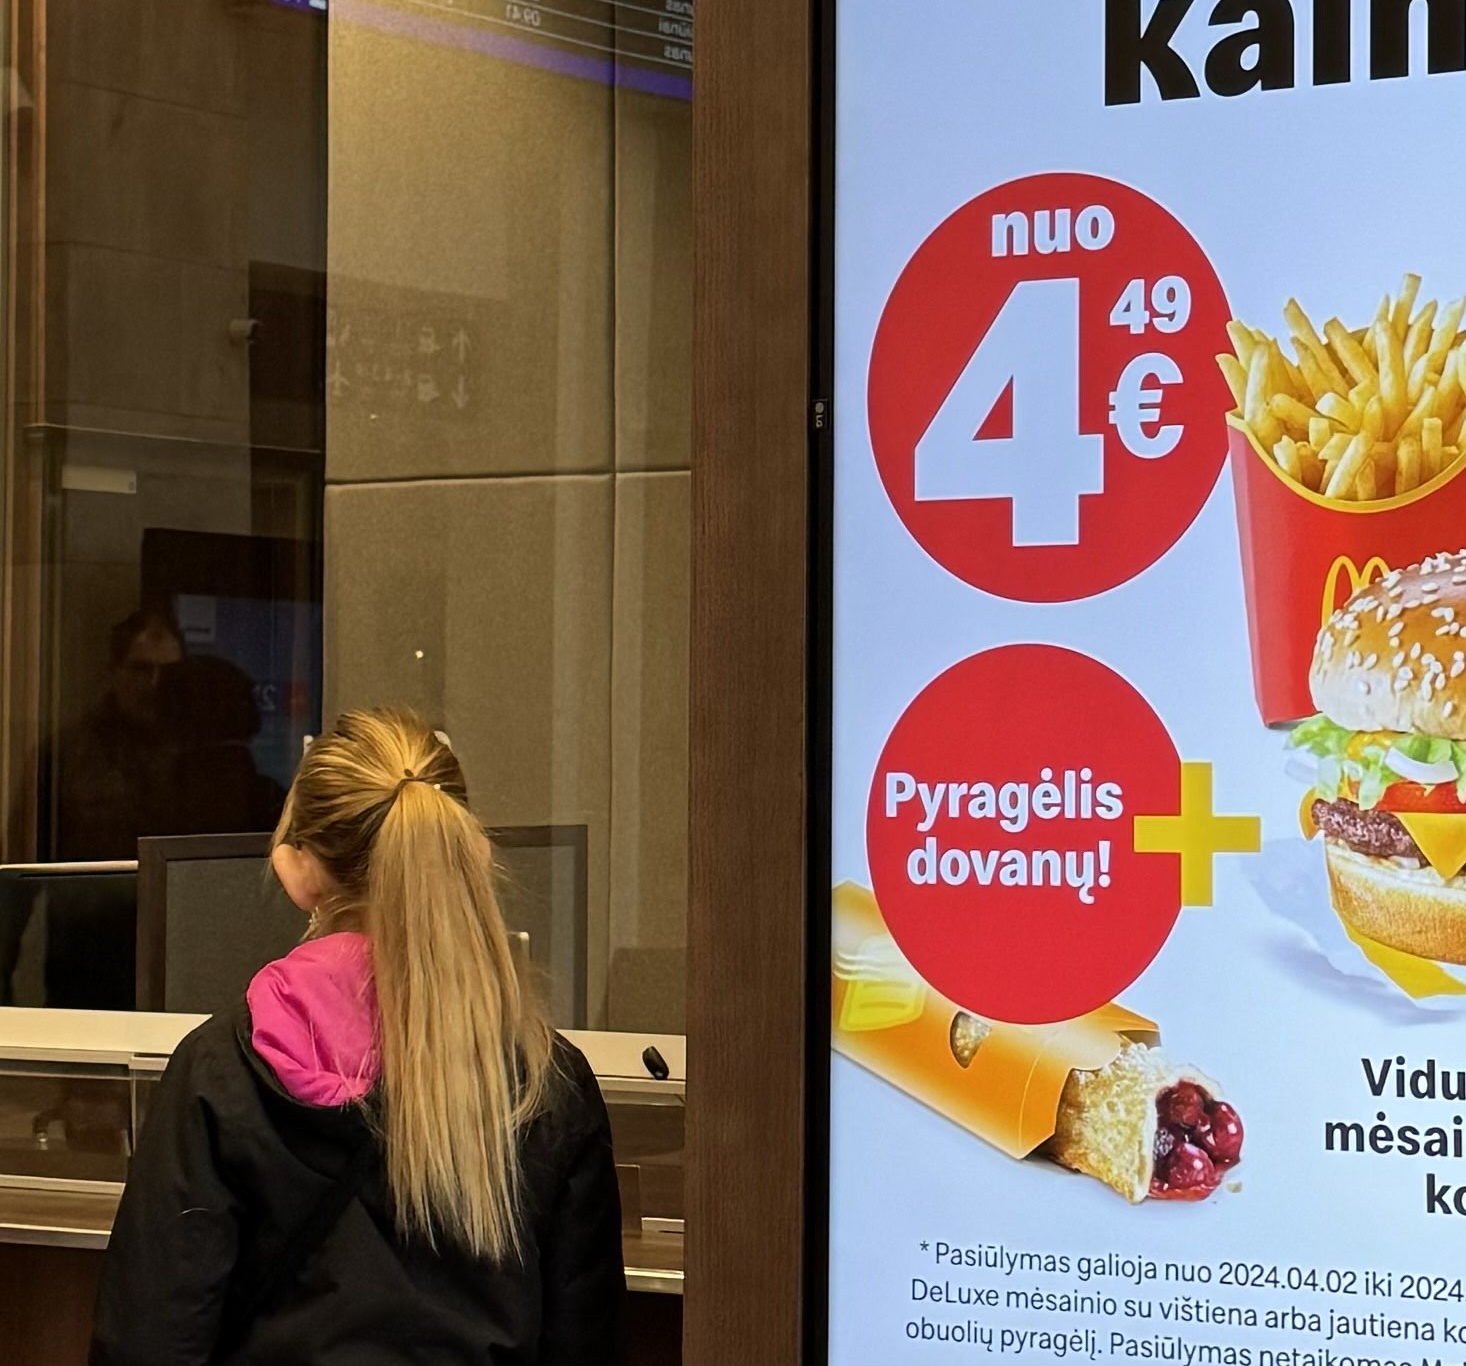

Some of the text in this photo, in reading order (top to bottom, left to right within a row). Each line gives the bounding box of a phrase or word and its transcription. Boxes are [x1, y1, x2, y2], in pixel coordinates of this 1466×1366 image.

[990, 202, 1116, 258] nuo
[912, 275, 1192, 548] 4 49
[883, 770, 1125, 824] Pyragėlis
[906, 838, 1112, 905] dovanų!
[936, 1241, 1071, 1276] Pasiūlymas
[1077, 1252, 1157, 1286] galioja
[1165, 1263, 1212, 1285] nuo
[1219, 1261, 1358, 1295] 2024.04.02
[1364, 1271, 1393, 1298] iki
[911, 1278, 1000, 1308] DeLuxe
[1006, 1283, 1118, 1317] mėsainio
[1124, 1299, 1152, 1320] su
[1159, 1293, 1258, 1327] vištiena
[1264, 1305, 1321, 1334] arba
[1325, 1309, 1436, 1341] jautiena
[905, 1316, 993, 1353] obuolių
[1000, 1321, 1102, 1362] pyragėlį.
